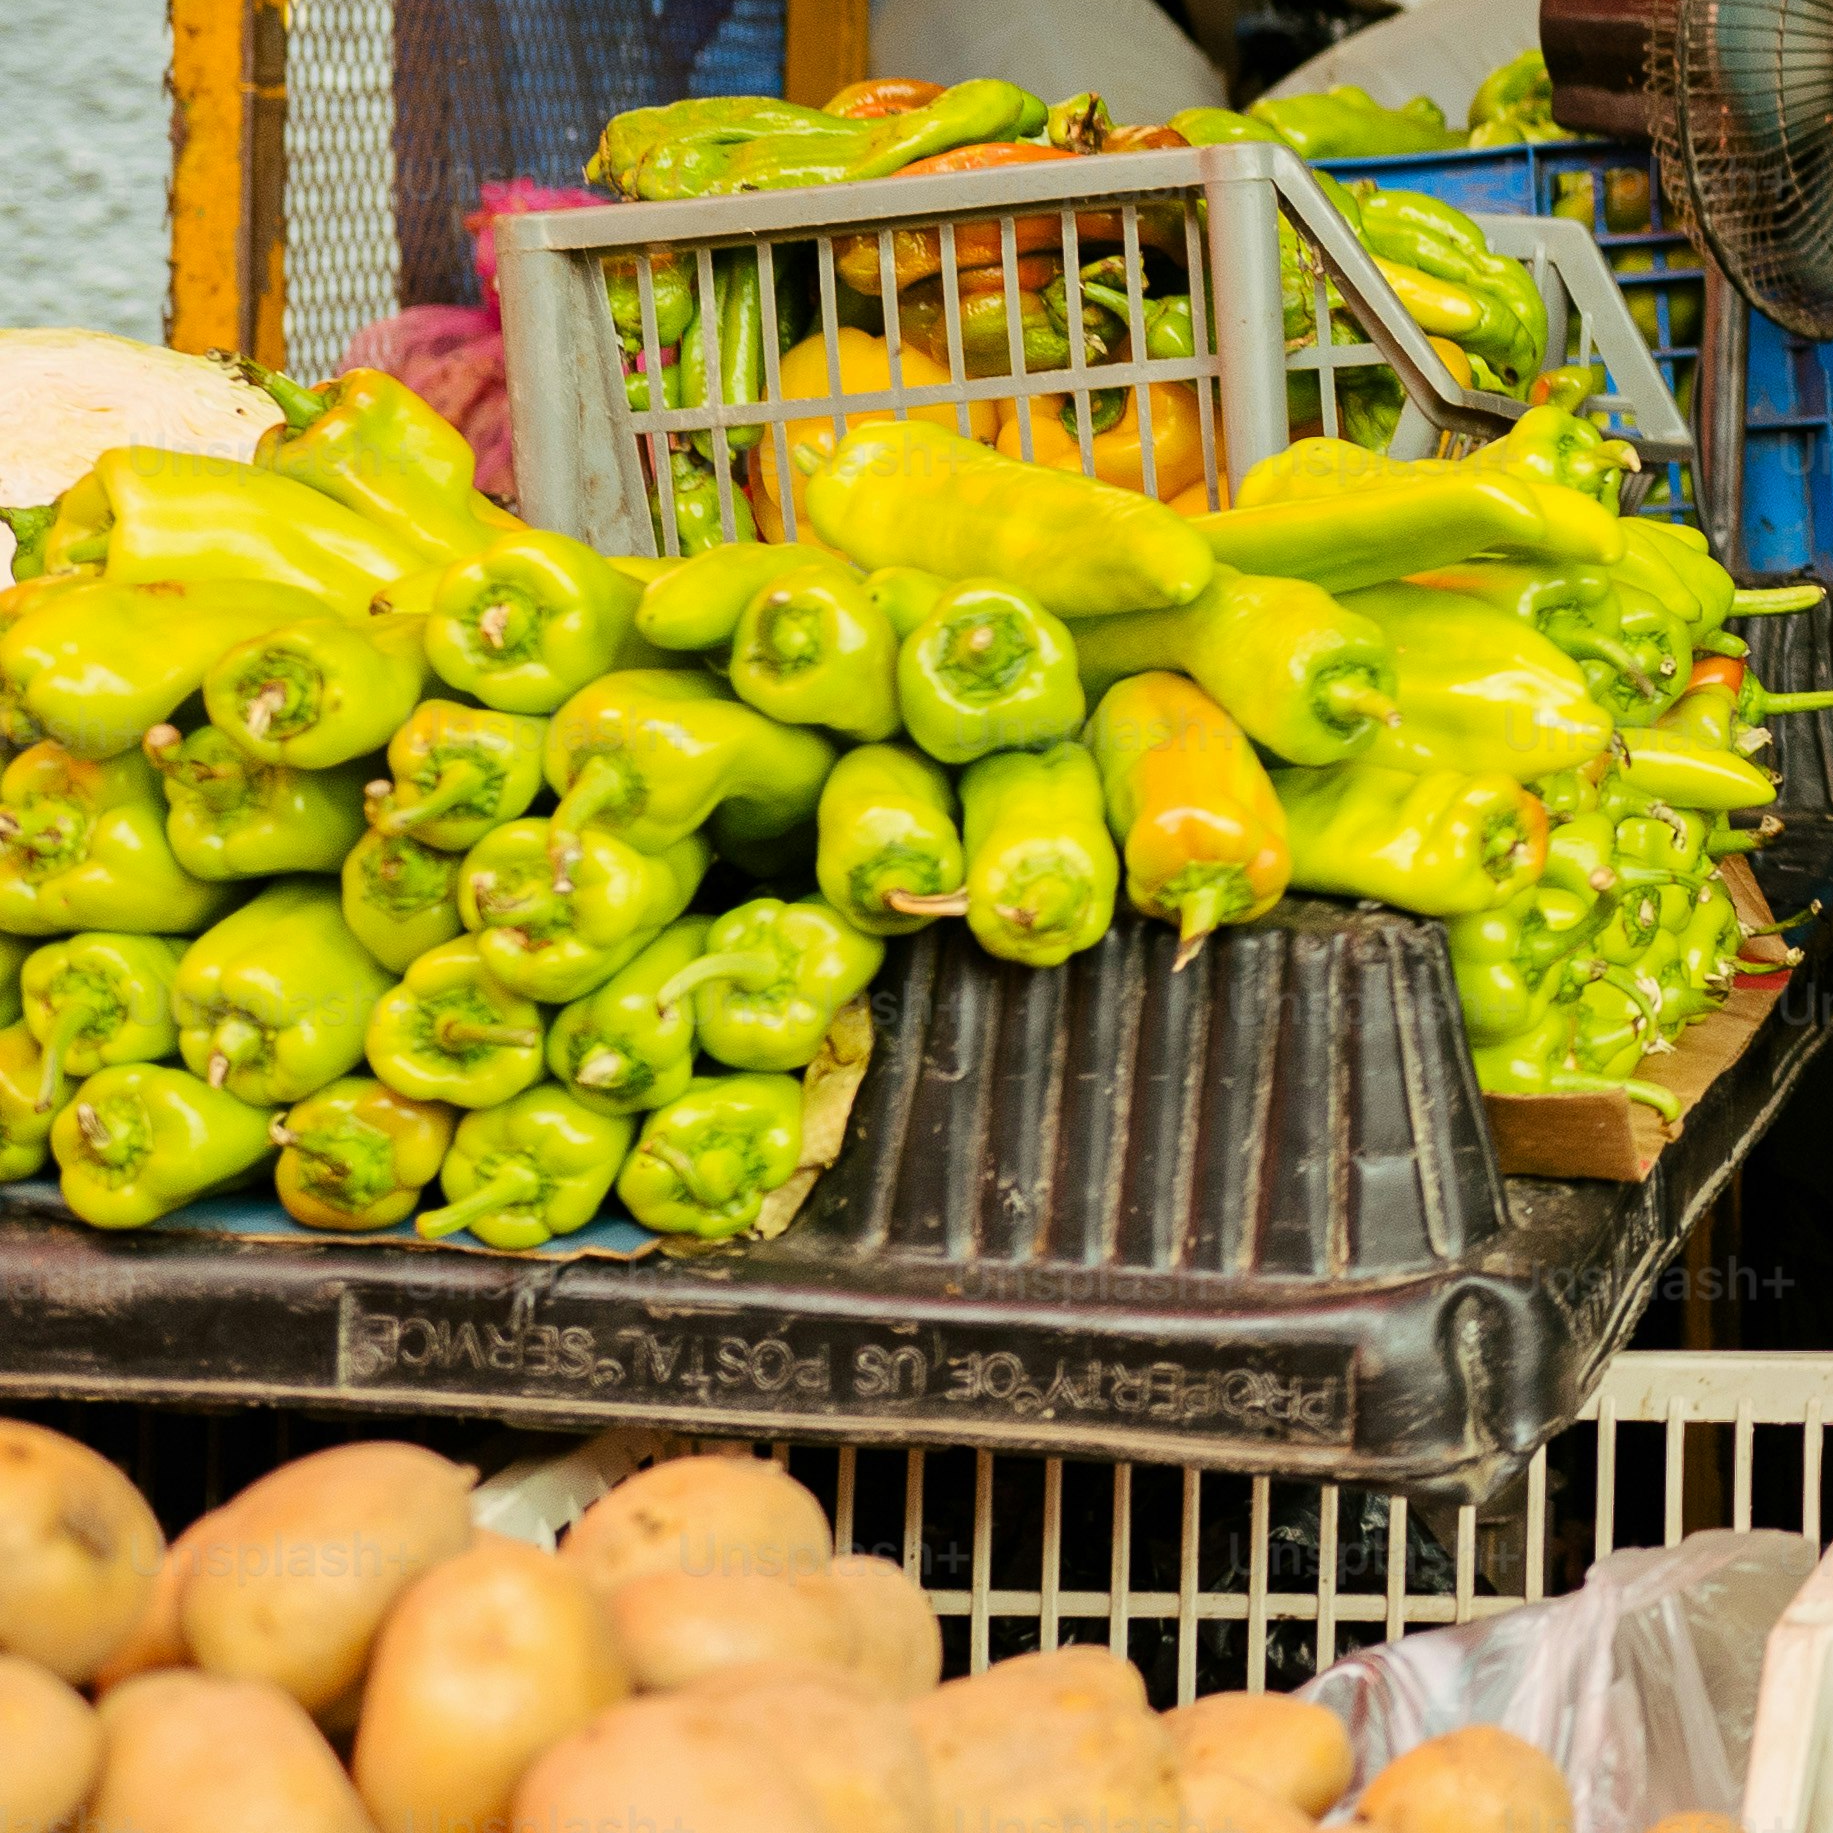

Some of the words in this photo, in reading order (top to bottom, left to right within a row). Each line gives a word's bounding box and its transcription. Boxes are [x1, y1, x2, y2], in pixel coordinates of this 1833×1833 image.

[360, 1314, 597, 1380] SERVICE
[618, 1327, 832, 1394] POSTAL
[853, 1344, 928, 1401] US
[946, 1352, 1024, 1402] OF
[1046, 1360, 1338, 1425] PROPERTY
